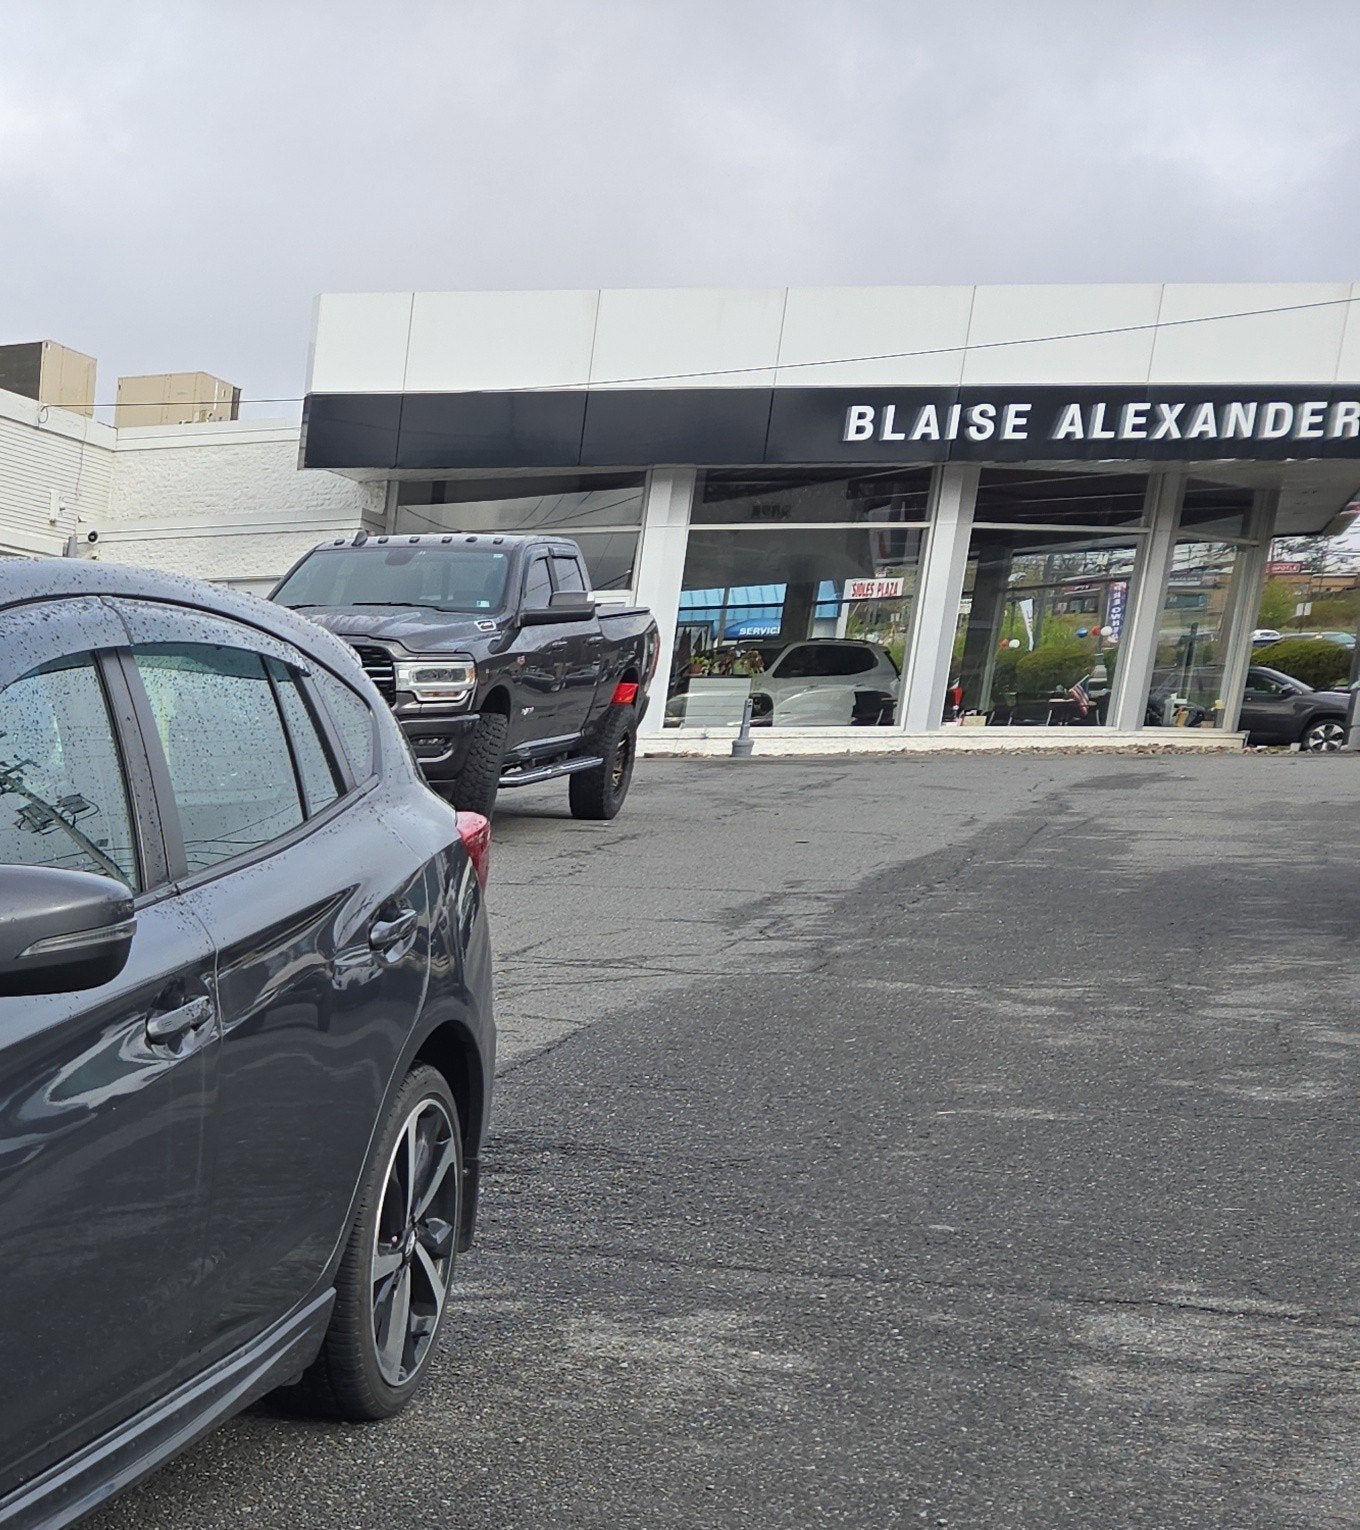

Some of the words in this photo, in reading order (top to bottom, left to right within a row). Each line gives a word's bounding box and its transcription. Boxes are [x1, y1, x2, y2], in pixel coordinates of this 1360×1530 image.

[844, 403, 1032, 441] BLAISE
[1053, 401, 1360, 440] ALEXANDER
[876, 581, 899, 597] PLAZA
